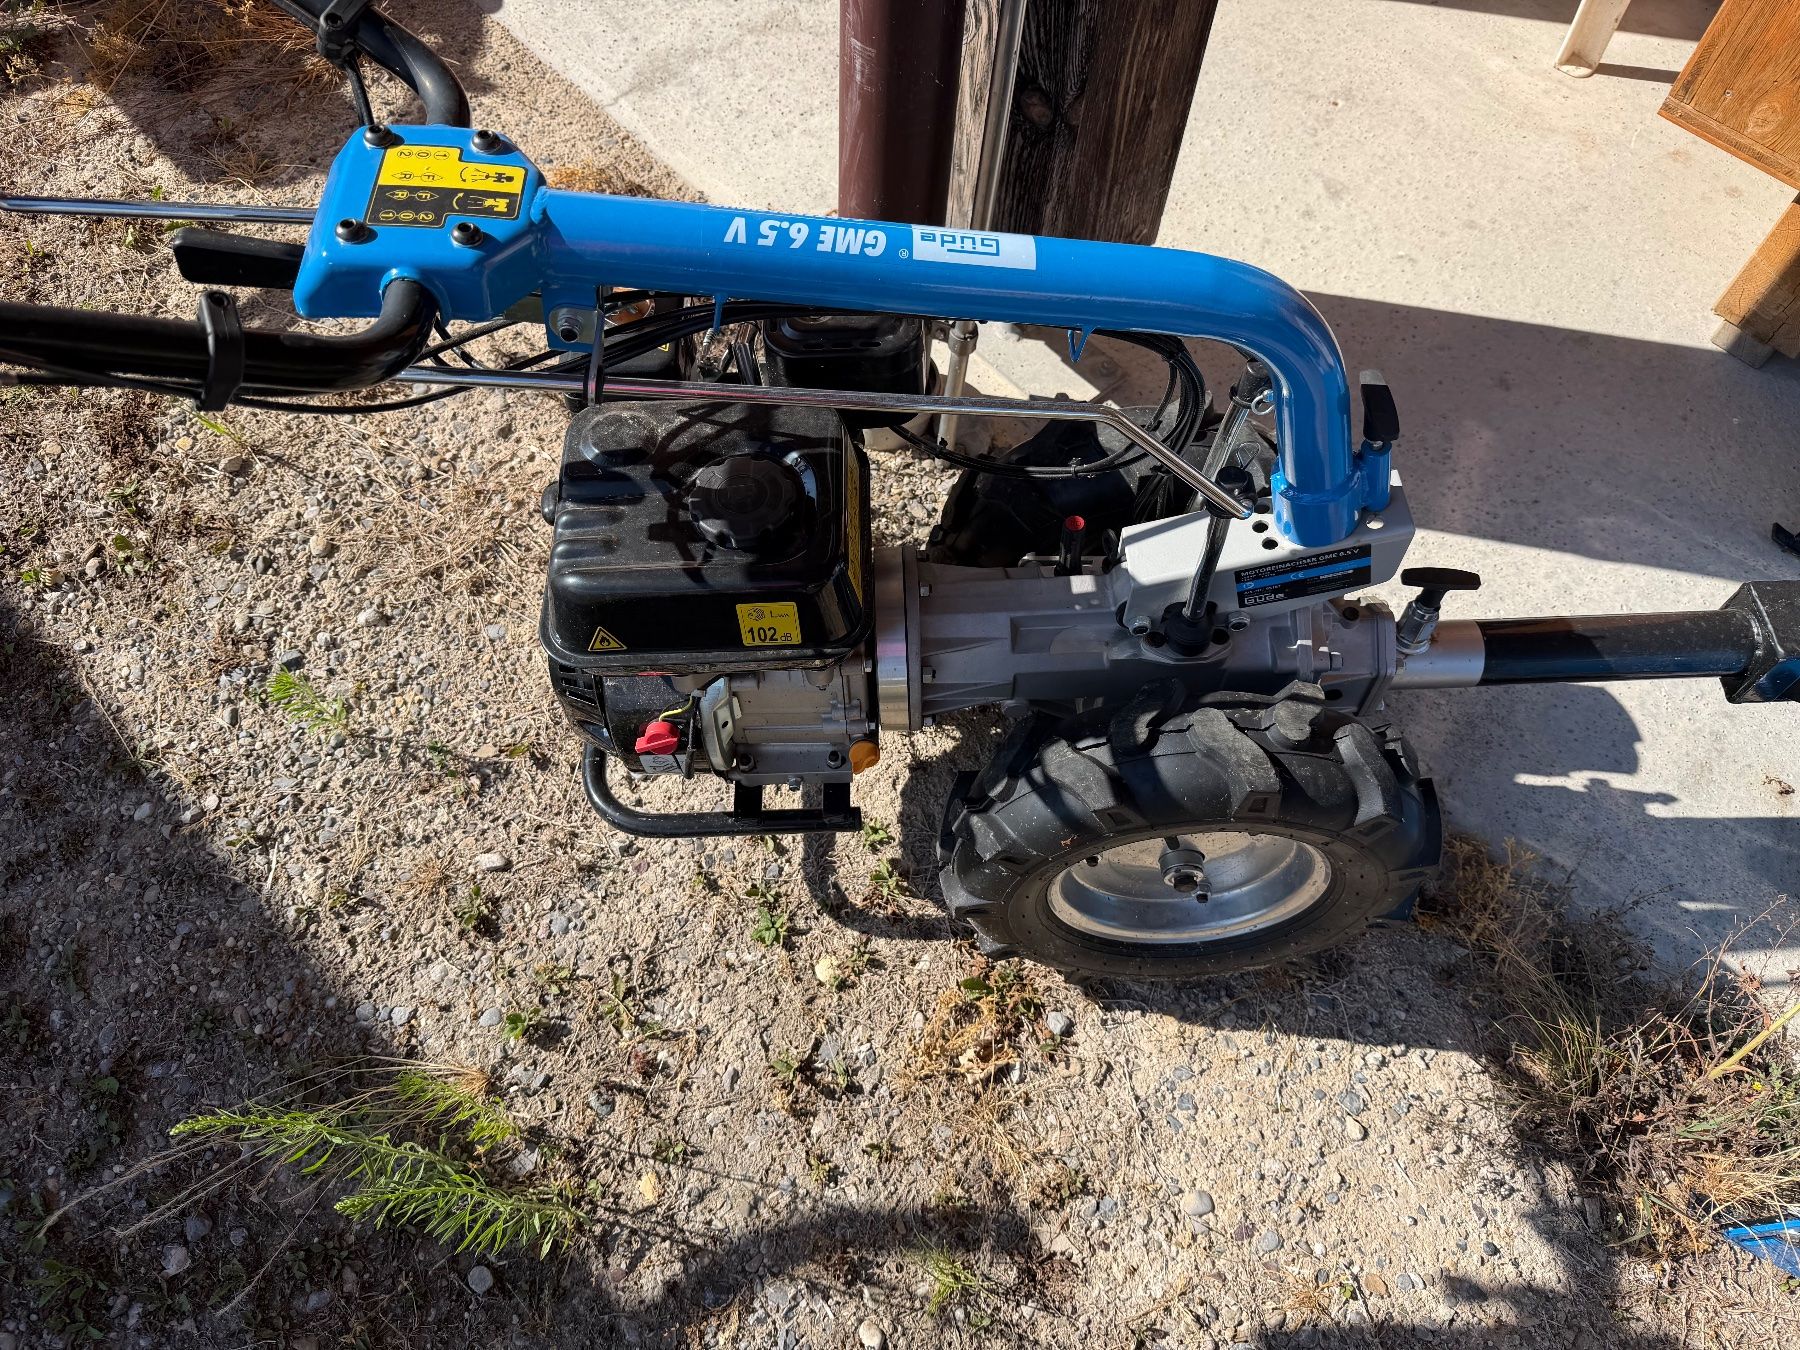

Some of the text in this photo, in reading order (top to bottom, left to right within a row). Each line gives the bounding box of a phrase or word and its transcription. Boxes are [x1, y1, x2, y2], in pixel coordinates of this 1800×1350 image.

[723, 216, 747, 244] V
[757, 219, 810, 249] 6.5
[816, 225, 887, 257] GME
[919, 231, 1000, 257] Güde
[747, 626, 793, 643] 102 dB
